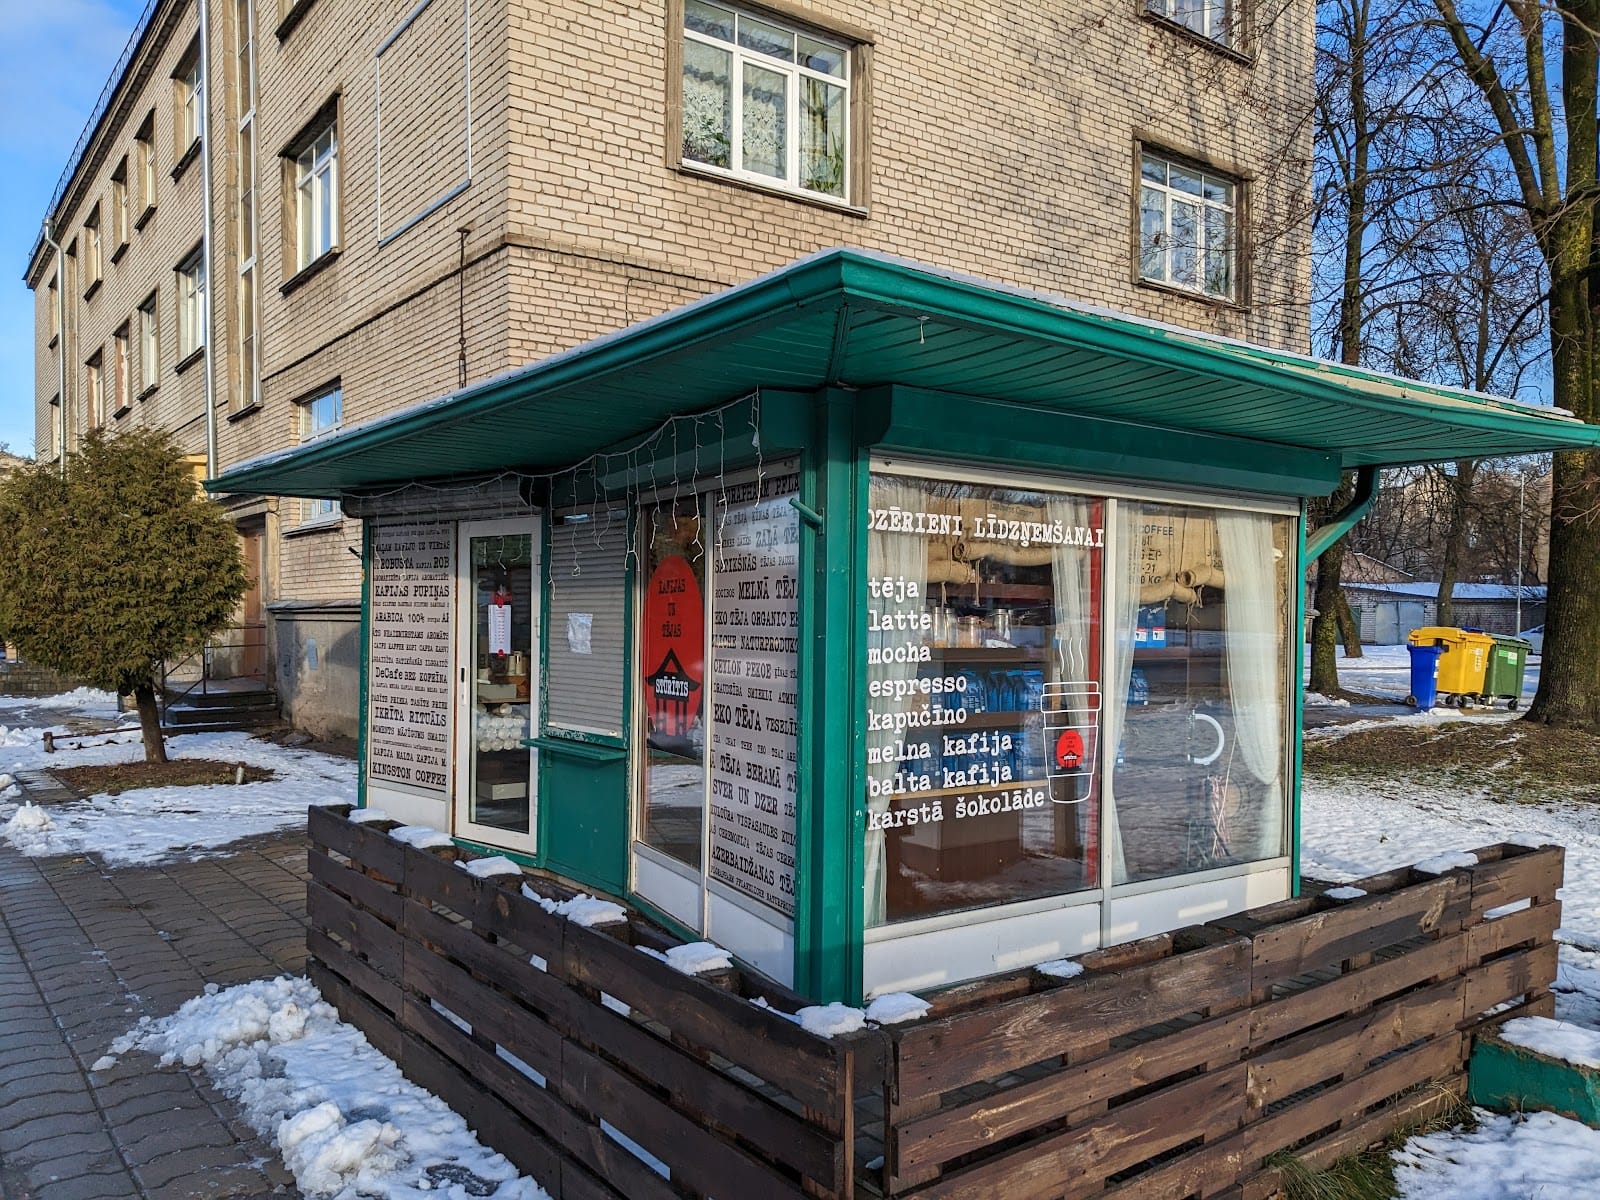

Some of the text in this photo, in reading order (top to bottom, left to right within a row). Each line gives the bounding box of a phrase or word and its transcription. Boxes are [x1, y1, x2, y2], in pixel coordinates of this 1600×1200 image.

[973, 514, 1105, 548] LĪDZŅEMŠANAI
[375, 585, 450, 601] KAFIJAS PUPIŅAS
[738, 576, 770, 600] MELNĀ
[775, 575, 798, 600] TĒJ
[867, 576, 919, 603] tēja
[375, 612, 404, 623] ARABICA
[730, 608, 749, 626] TĒJA
[751, 611, 787, 627] ORGANIC
[868, 609, 932, 631] latte
[867, 641, 932, 665] mocha
[375, 666, 403, 680] DeCafe
[713, 658, 741, 676] CEYLON
[868, 675, 968, 702] espresso
[409, 710, 447, 727] RITUĀLS
[714, 703, 731, 725] EKO
[735, 704, 761, 731] TĒJA
[867, 703, 968, 734] kapučīno
[867, 730, 1013, 765] melna kafija
[372, 761, 447, 787] KINGSTON COFFEE
[720, 753, 741, 777] TĒJA
[746, 762, 781, 789] BERAMĀ
[867, 761, 1013, 797] balta kafija
[713, 779, 733, 800] SVER
[738, 787, 749, 806] UN
[754, 792, 778, 816] DZER
[867, 788, 1046, 831] karstā šokolāde
[712, 844, 775, 887] AZERBAIDŽANAS
